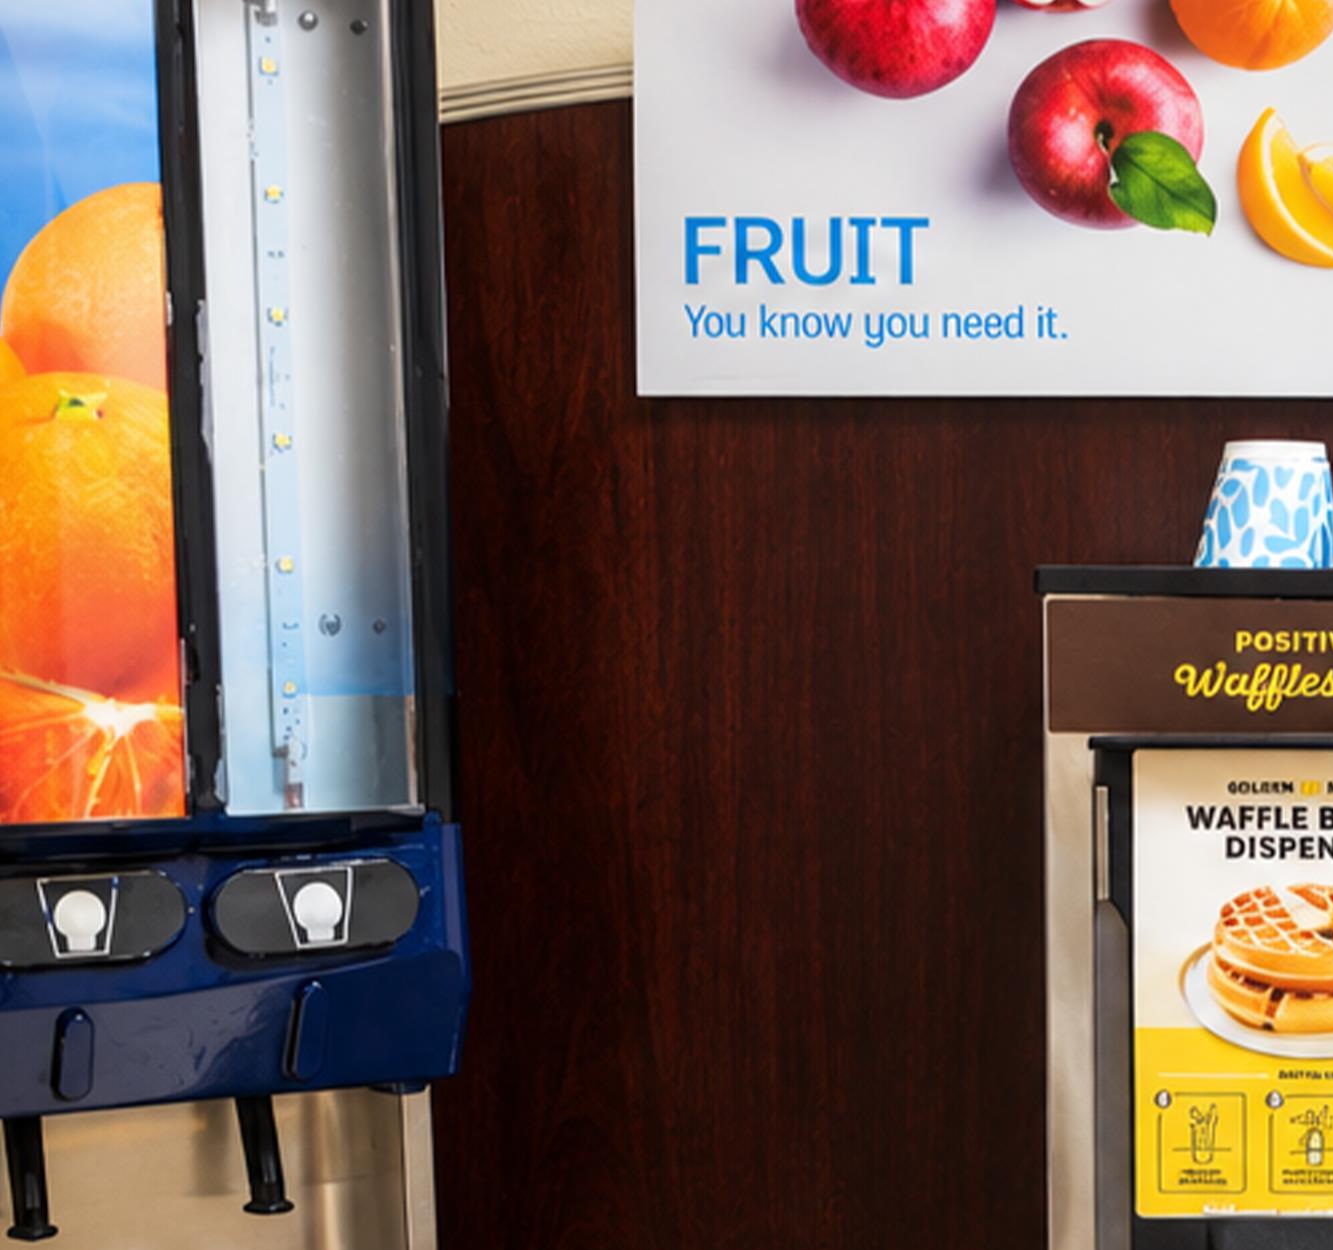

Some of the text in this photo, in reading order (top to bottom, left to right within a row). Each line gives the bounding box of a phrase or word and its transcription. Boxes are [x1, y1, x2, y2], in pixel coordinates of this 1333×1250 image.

[684, 216, 930, 285] FRUIT
[685, 304, 1069, 349] You know you need it.
[1187, 806, 1308, 831] WAFFLE
